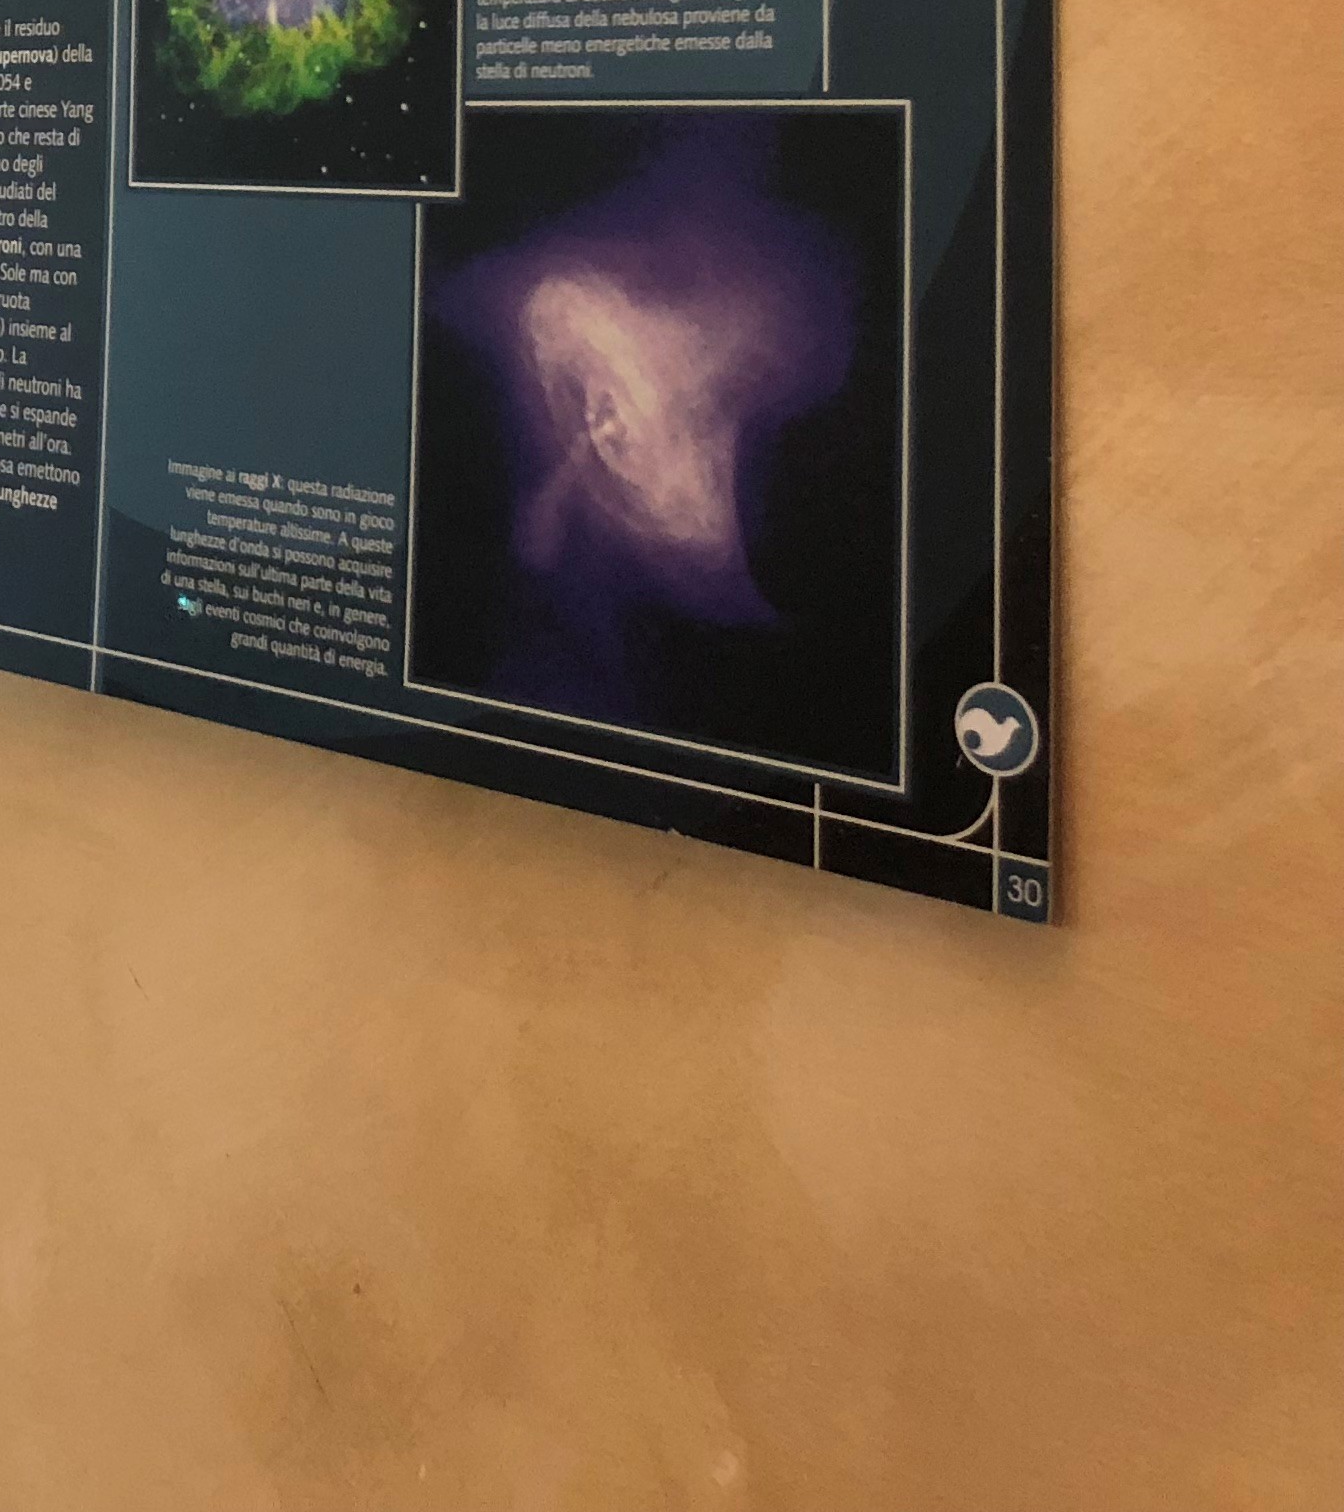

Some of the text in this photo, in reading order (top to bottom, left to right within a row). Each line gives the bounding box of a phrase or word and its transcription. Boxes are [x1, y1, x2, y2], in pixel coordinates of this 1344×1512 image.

[4, 18, 11, 36] il
[14, 17, 60, 36] residuo
[61, 42, 93, 63] della
[23, 76, 32, 91] e
[17, 100, 58, 118] cinese
[60, 100, 94, 123] Yang
[7, 126, 30, 146] che
[33, 127, 65, 146] resta
[67, 126, 80, 146] di
[12, 152, 43, 178] degli
[36, 180, 56, 201] del
[17, 207, 48, 228] della
[29, 240, 53, 256] con
[56, 243, 82, 258] una
[1007, 874, 1043, 907] 30
